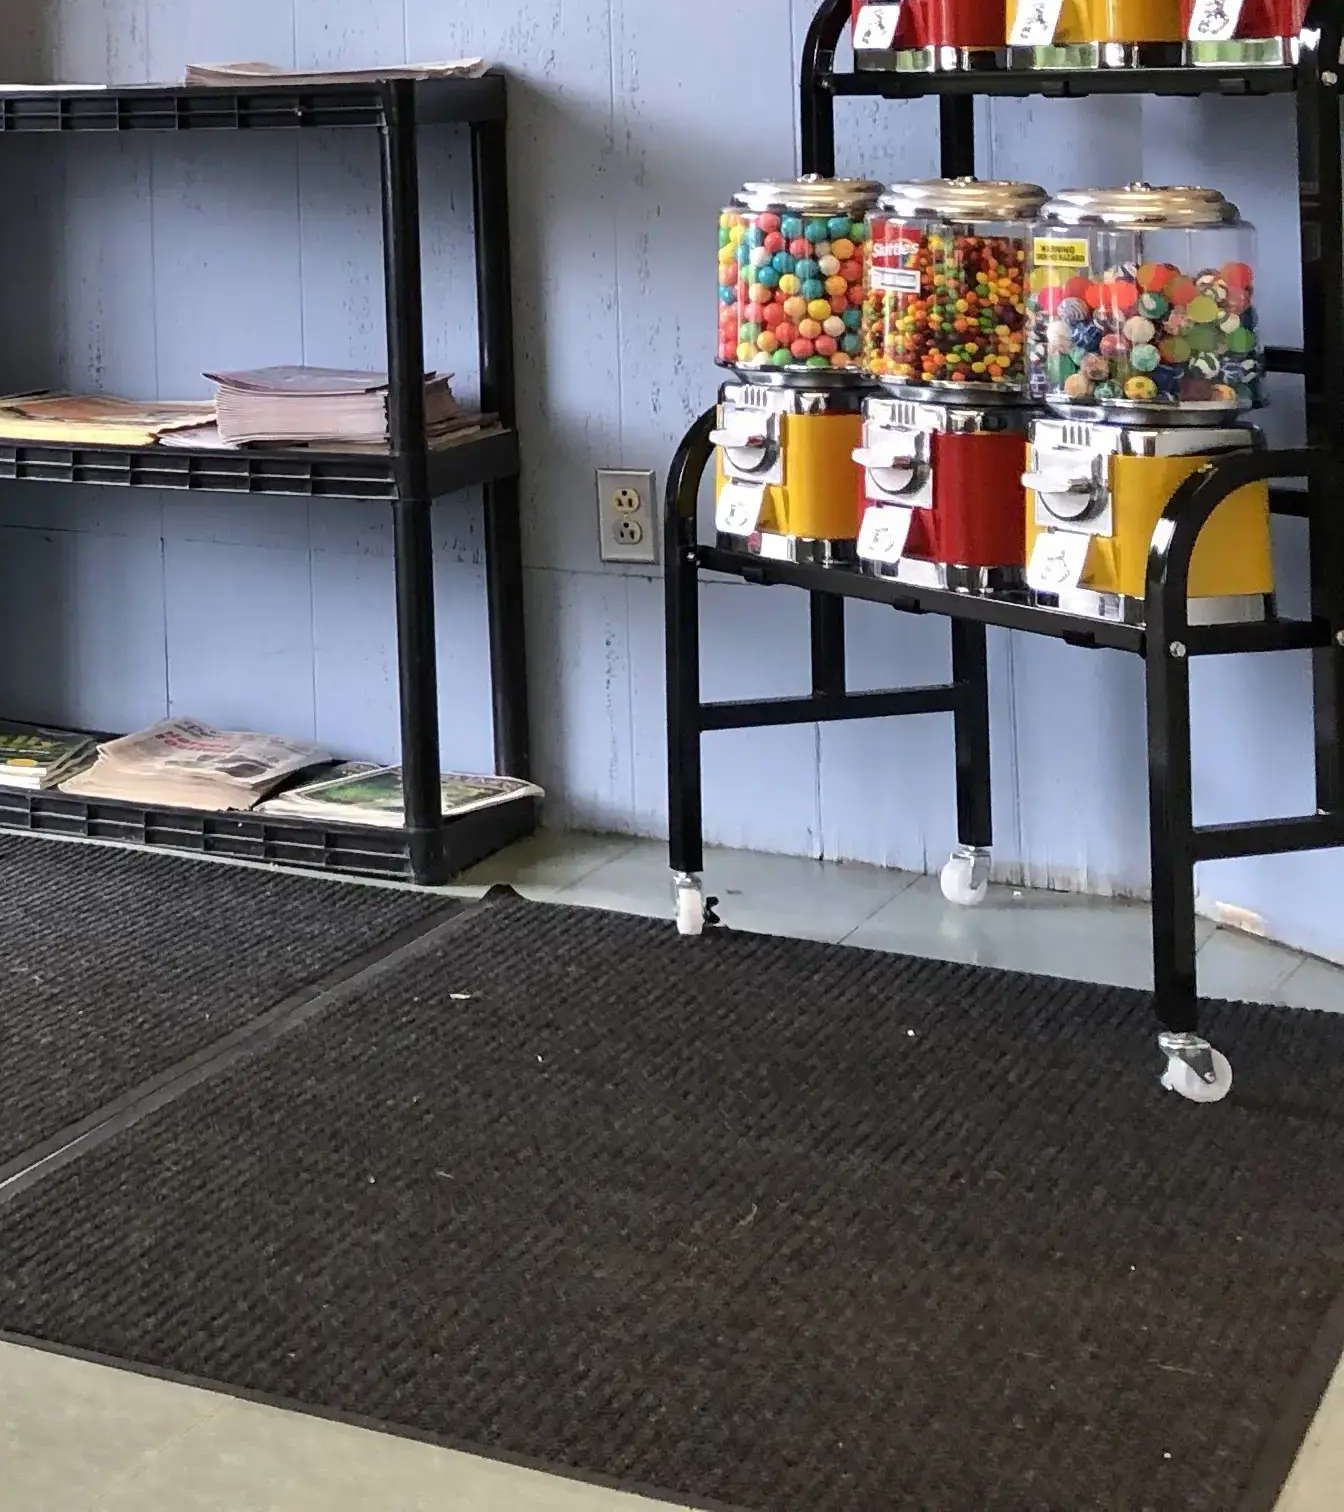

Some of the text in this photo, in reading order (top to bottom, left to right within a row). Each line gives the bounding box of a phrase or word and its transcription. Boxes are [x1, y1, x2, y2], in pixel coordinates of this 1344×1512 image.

[872, 241, 920, 258] Skittles
[1040, 245, 1075, 254] WARNING
[1059, 253, 1085, 261] HAZARD
